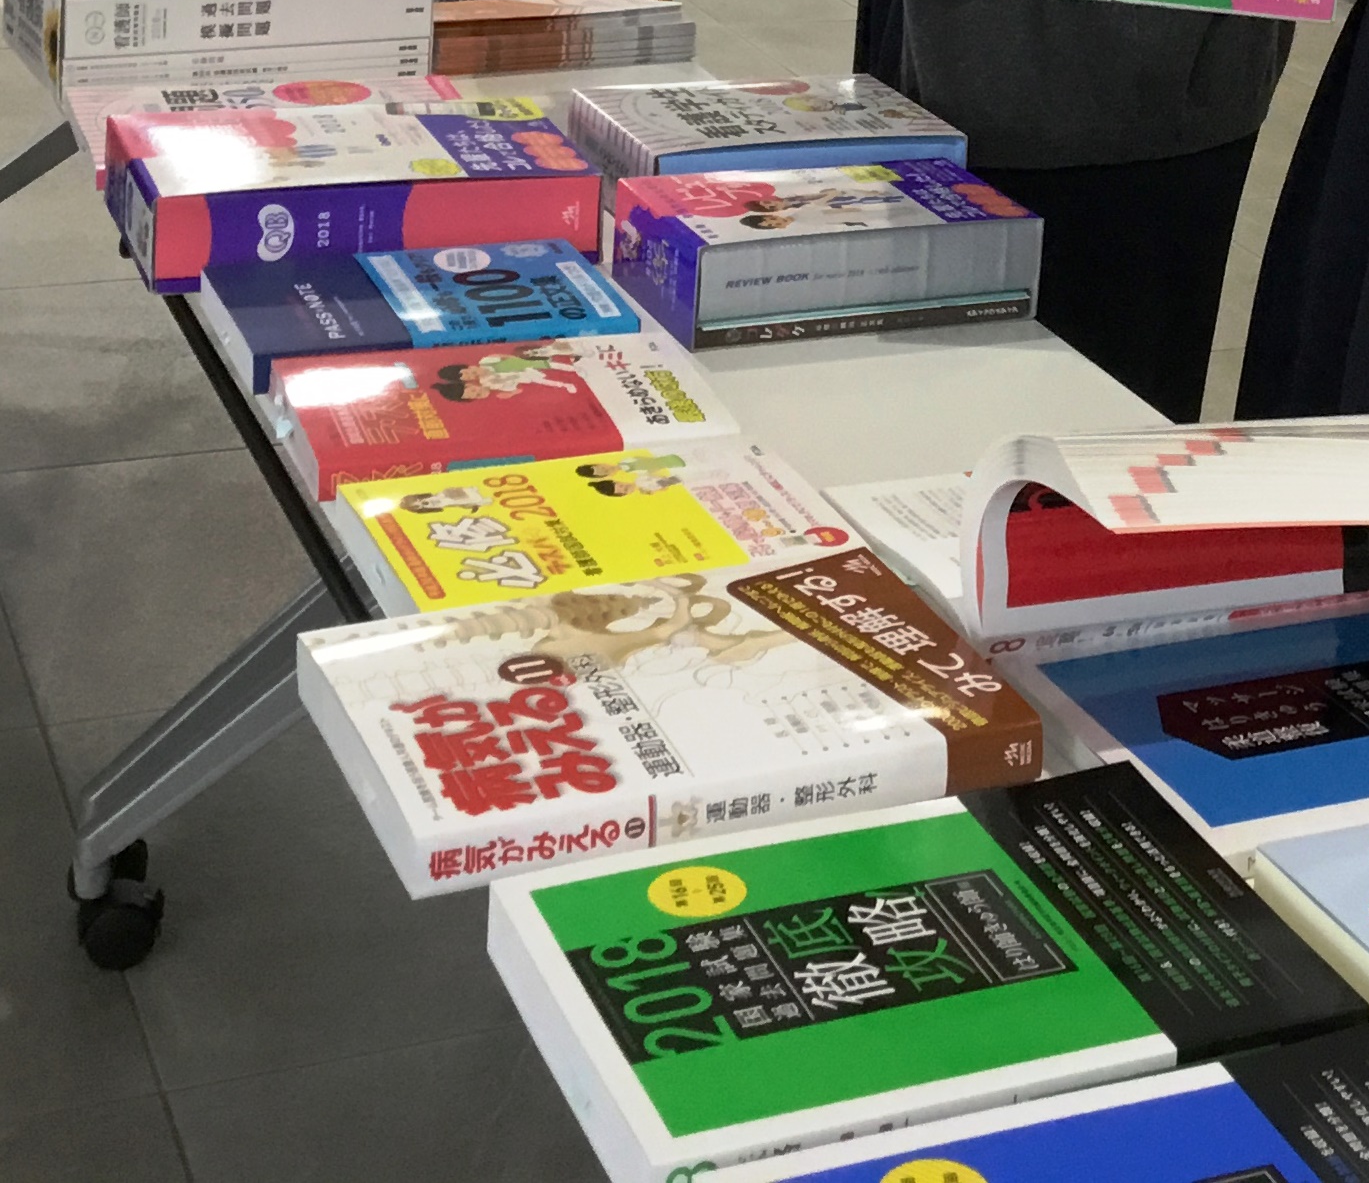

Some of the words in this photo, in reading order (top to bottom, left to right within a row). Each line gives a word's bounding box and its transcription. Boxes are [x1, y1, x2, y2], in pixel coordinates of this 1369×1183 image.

[264, 212, 292, 253] QB
[317, 211, 330, 248] 2018
[725, 276, 772, 289] REVIEW
[775, 272, 809, 284] BOOK
[479, 472, 558, 522] 2018
[425, 515, 547, 591] 必修
[777, 567, 1003, 699] みて理解する!
[390, 693, 543, 816] 病気が
[486, 682, 617, 800] みえる
[430, 819, 621, 882] 病気がみえる
[590, 929, 745, 1059] 2018
[679, 930, 775, 1028] 国家試験
[766, 907, 899, 1013] 徹底
